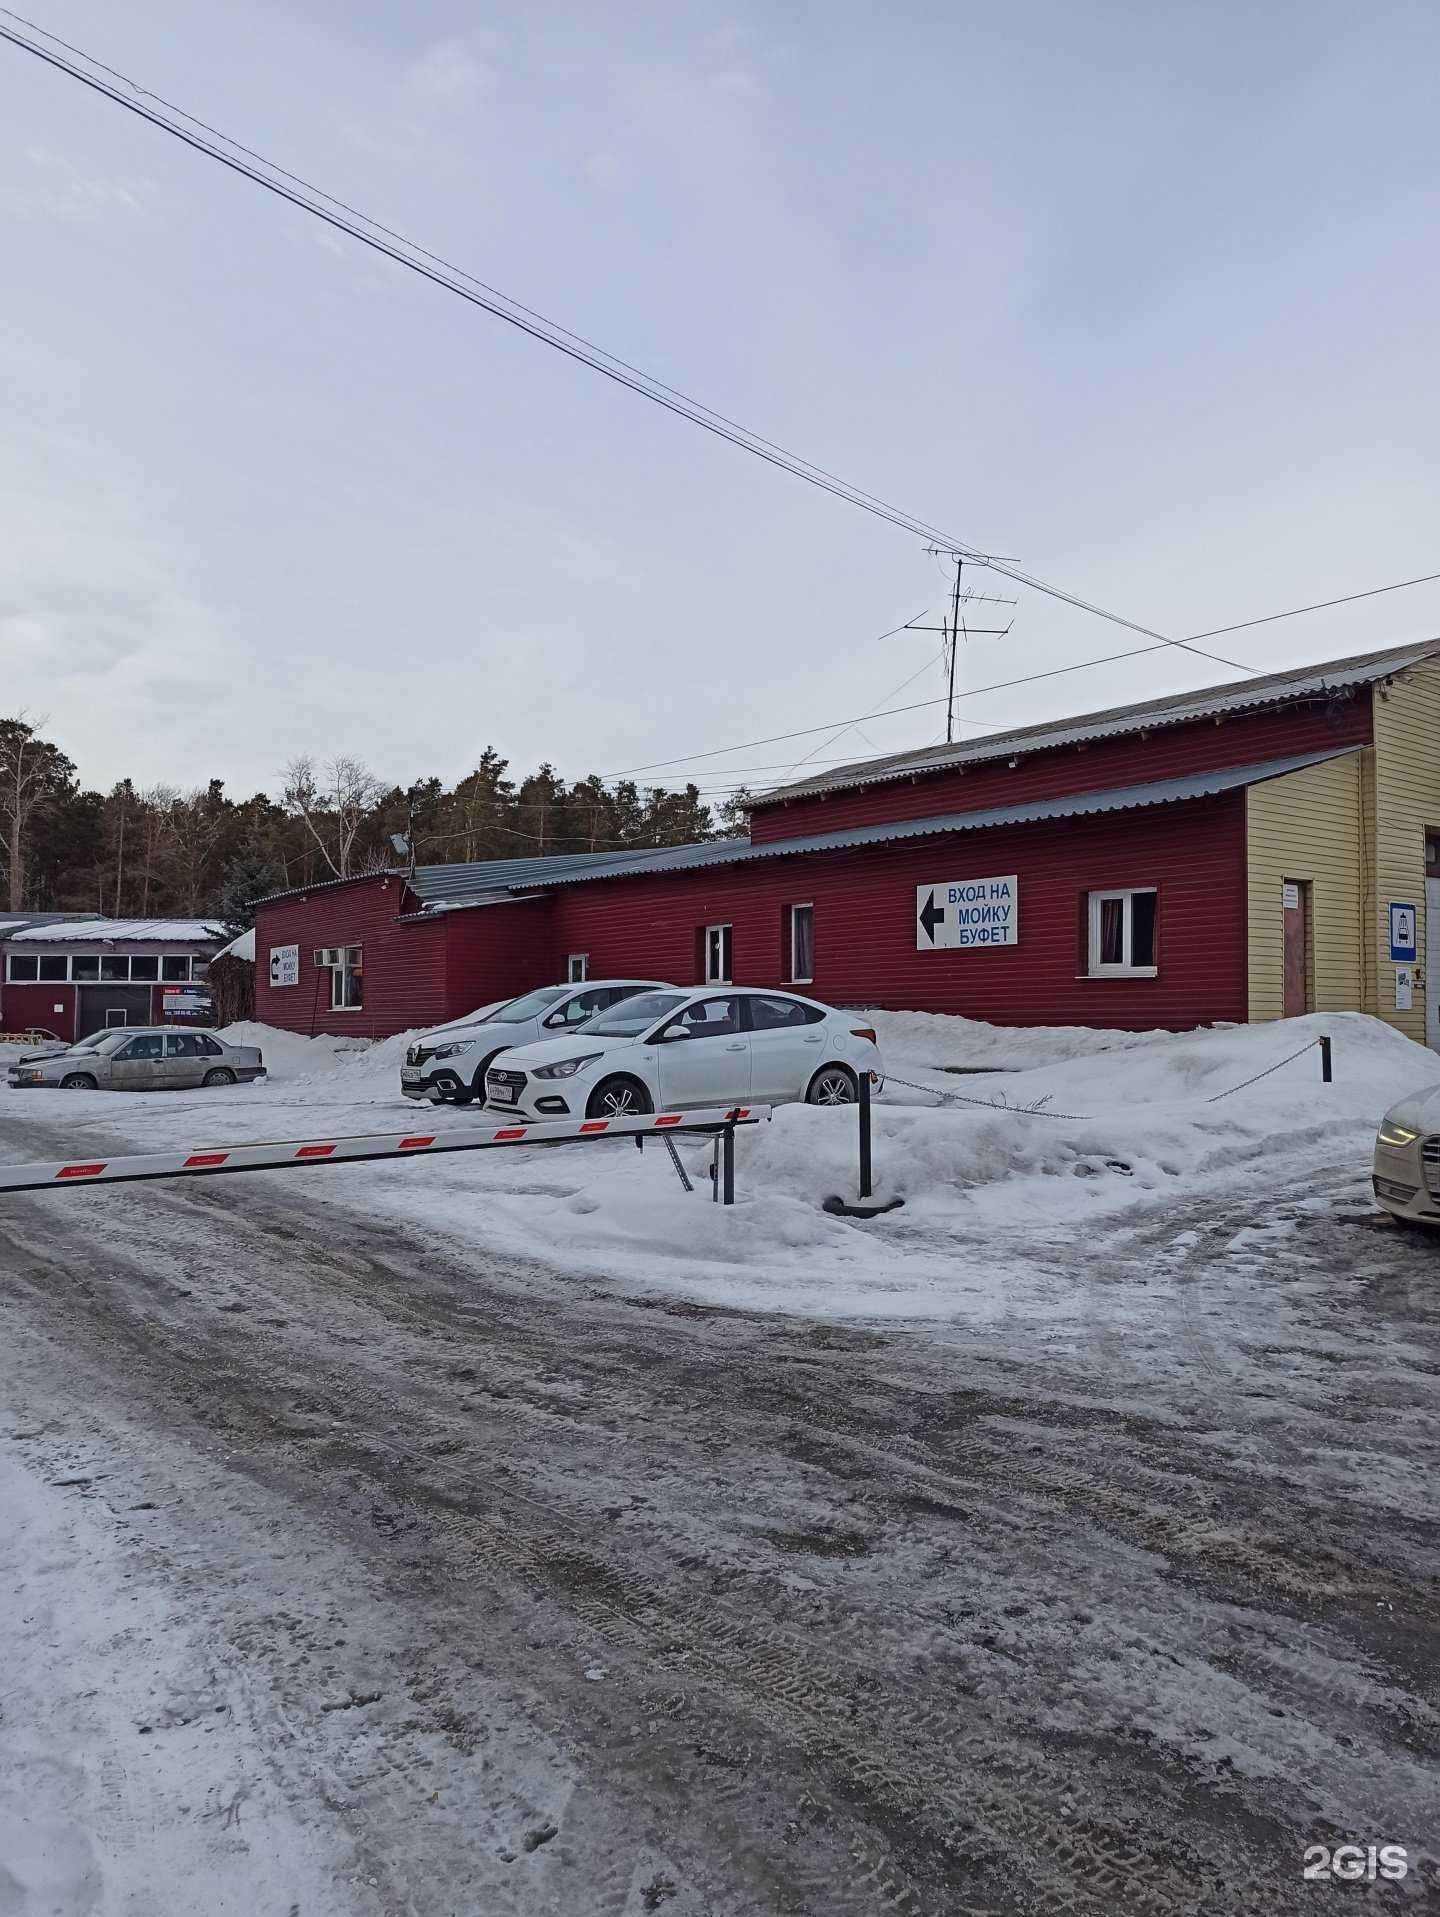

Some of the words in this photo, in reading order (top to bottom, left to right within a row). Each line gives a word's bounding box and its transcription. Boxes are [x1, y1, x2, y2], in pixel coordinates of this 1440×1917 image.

[948, 885, 986, 904] ВХОД
[990, 882, 1011, 899] НА
[958, 903, 1011, 925] МОЙКУ
[959, 925, 1010, 945] БУФЕТ
